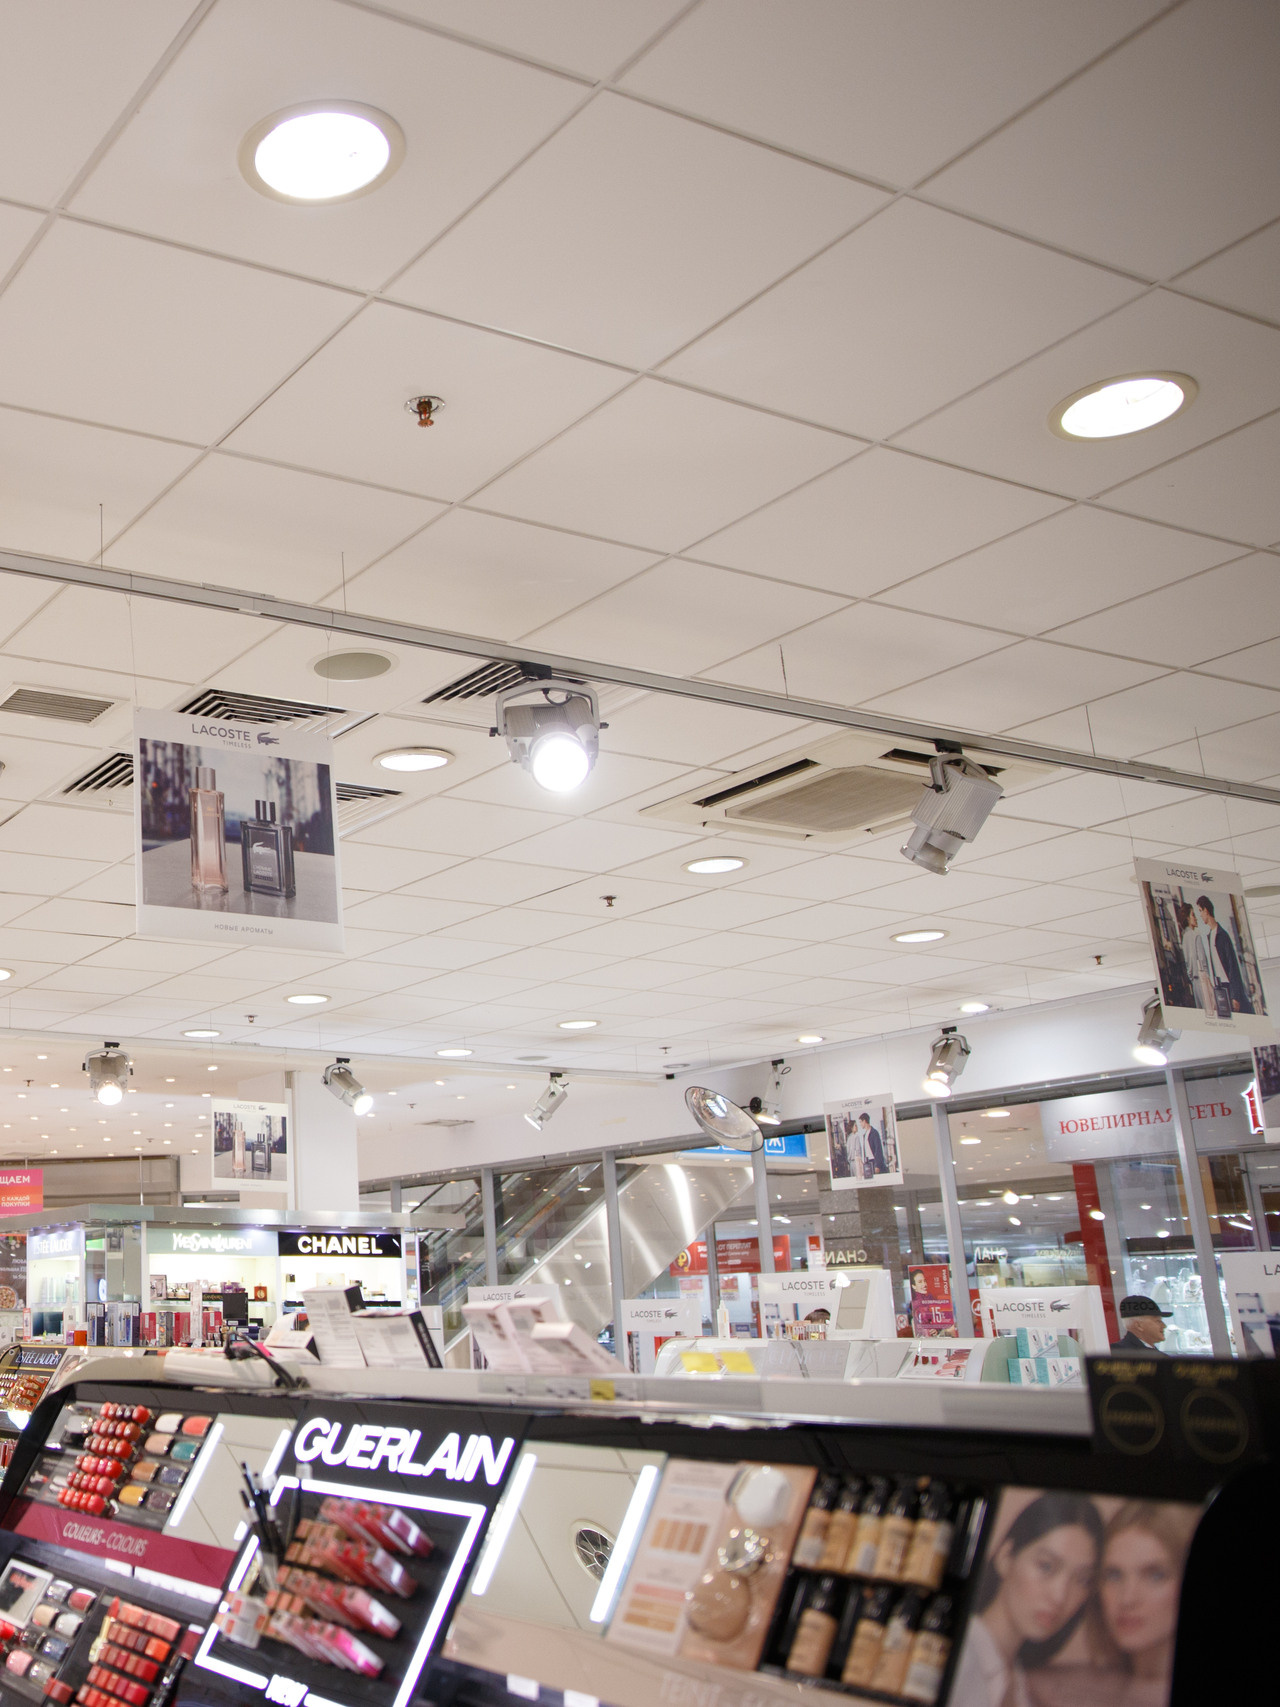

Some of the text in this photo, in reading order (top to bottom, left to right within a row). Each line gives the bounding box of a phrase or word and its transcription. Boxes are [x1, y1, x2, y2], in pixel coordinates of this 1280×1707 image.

[191, 723, 251, 742] LACOSTE
[222, 739, 252, 749] TIMELESS
[1166, 867, 1199, 881] LACOSTE
[214, 923, 274, 935] НОВЫЕ АРОМАТЫ
[1058, 1108, 1173, 1135] ЮВЕЛИРНАЯ
[297, 1235, 383, 1255] CHANEL
[781, 1280, 825, 1291] LACOSTE
[483, 1291, 512, 1302] LACOSTE
[996, 1302, 1045, 1312] LACOSTE
[630, 1310, 662, 1318] LACOSTE
[294, 1417, 515, 1486] GUERLAIN
